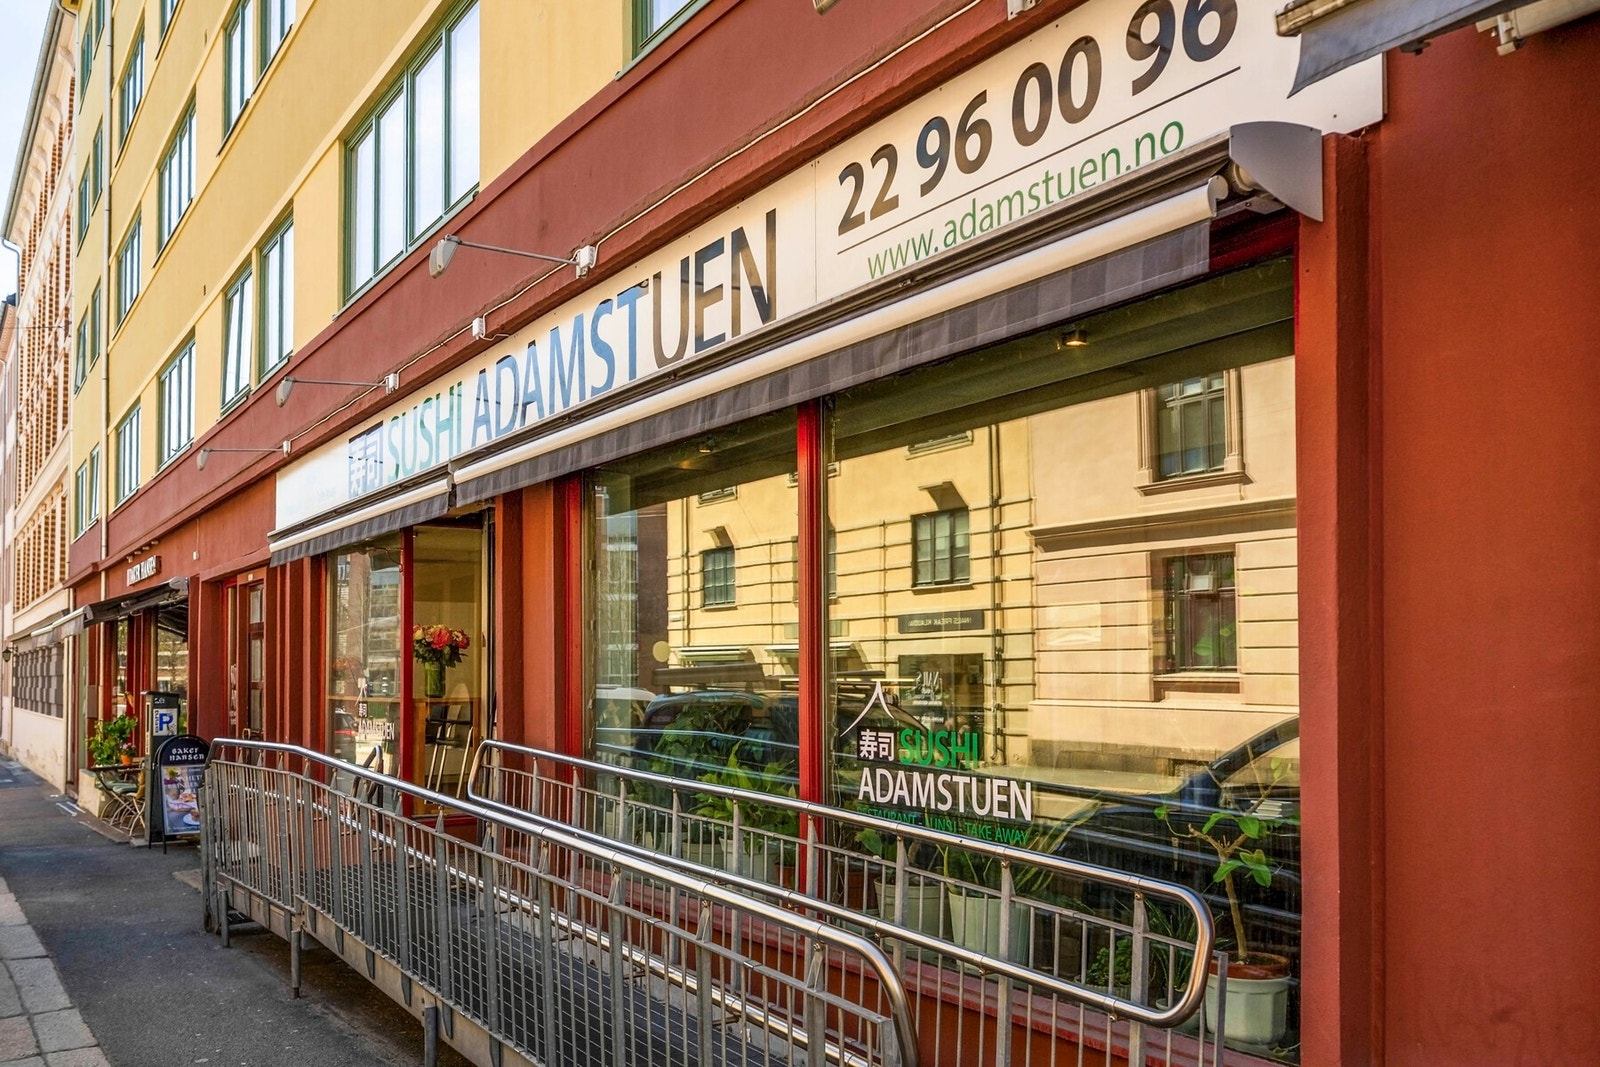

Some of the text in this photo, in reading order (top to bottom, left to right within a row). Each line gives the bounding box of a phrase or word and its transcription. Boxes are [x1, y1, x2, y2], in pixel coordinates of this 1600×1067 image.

[838, 0, 1238, 235] 22 96 00 96
[867, 120, 1185, 280] www.adamstuen.no
[388, 209, 777, 484] SUSHI ADAMSTUEN
[159, 713, 173, 731] P
[859, 728, 895, 761] 寿司
[900, 728, 978, 769] SUSHI
[858, 767, 1032, 821] ADAMSTUEN
[965, 822, 992, 840] TAKE
[995, 826, 1029, 845] AWAY
